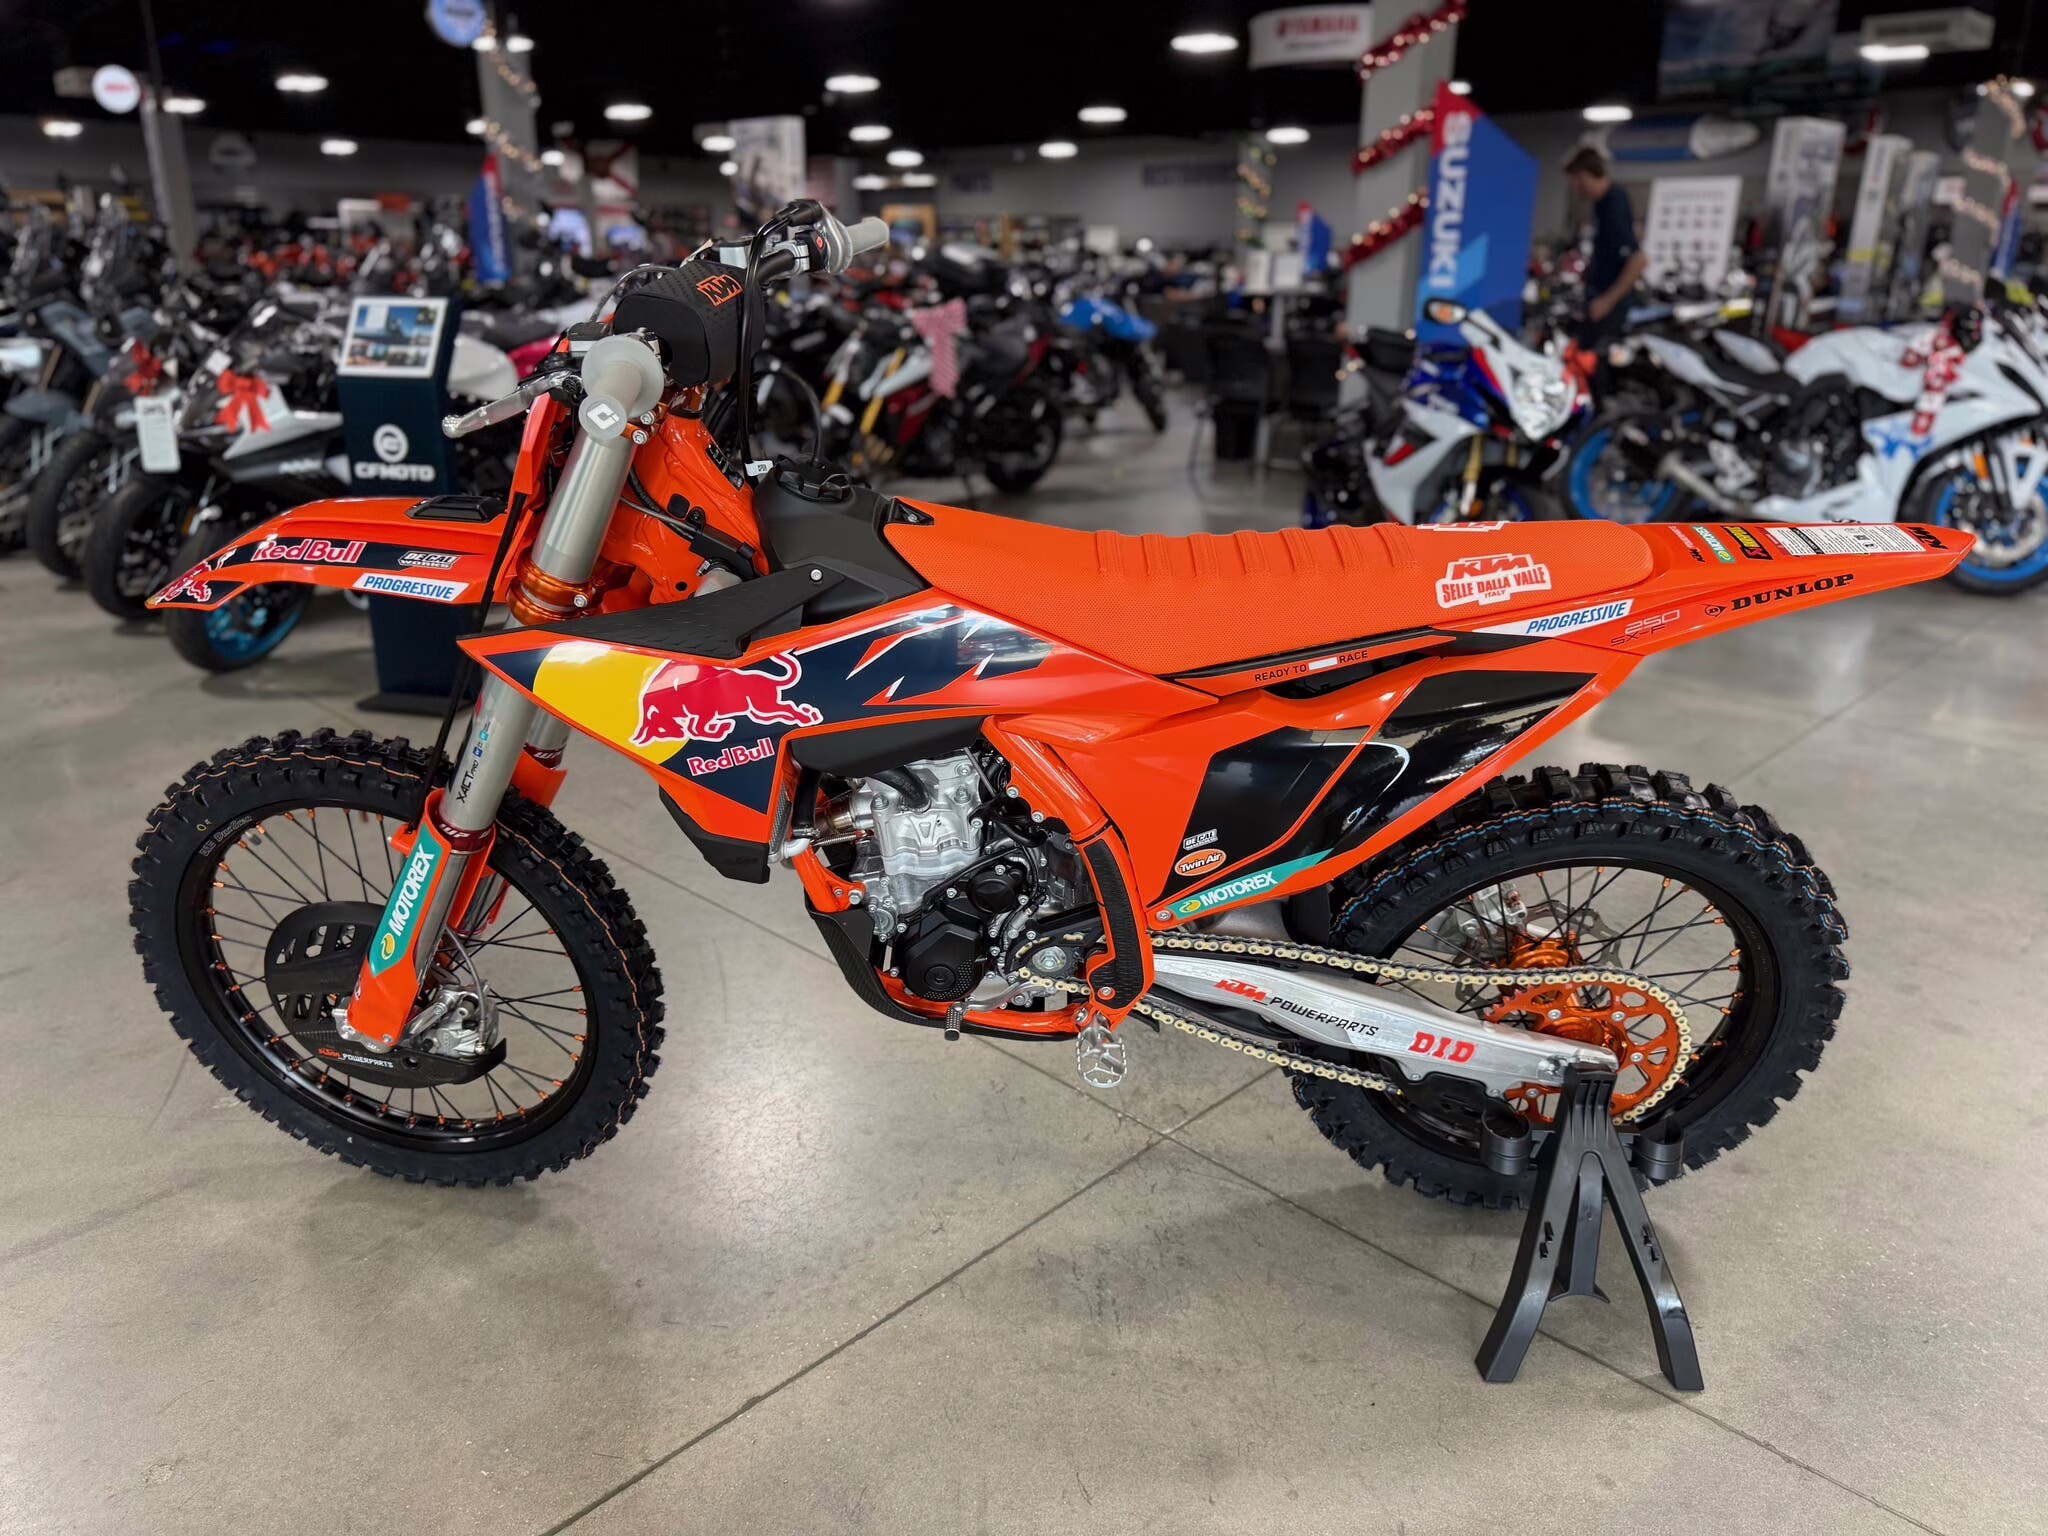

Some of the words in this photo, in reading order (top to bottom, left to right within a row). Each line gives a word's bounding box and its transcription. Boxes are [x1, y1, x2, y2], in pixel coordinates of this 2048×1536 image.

[1429, 111, 1472, 288] SUZUKI
[354, 462, 436, 482] CFMOTO
[251, 539, 307, 563] Red
[303, 540, 367, 564] Bull
[1452, 555, 1530, 580] KTM
[363, 575, 455, 600] PROGRESSIVE
[1441, 582, 1474, 603] SELLE
[1476, 576, 1511, 593] DALLA
[1513, 566, 1546, 586] VALLE
[1484, 589, 1506, 599] ITALY
[1731, 573, 1854, 611] DUNLOP
[1526, 602, 1627, 634] PROGRESSIVE
[1625, 609, 1680, 635] 250
[1610, 624, 1666, 647] SX-F
[1254, 667, 1290, 682] READY
[1293, 664, 1307, 675] TO
[1338, 650, 1368, 664] RACE
[687, 748, 734, 776] Red
[731, 737, 775, 766] Bull
[456, 770, 474, 804] XACT
[1180, 858, 1205, 873] Twin
[1205, 852, 1222, 864] Air
[388, 842, 435, 937] MOTOREX
[1200, 871, 1279, 907] MOTOREX
[1214, 979, 1267, 1002] KTM
